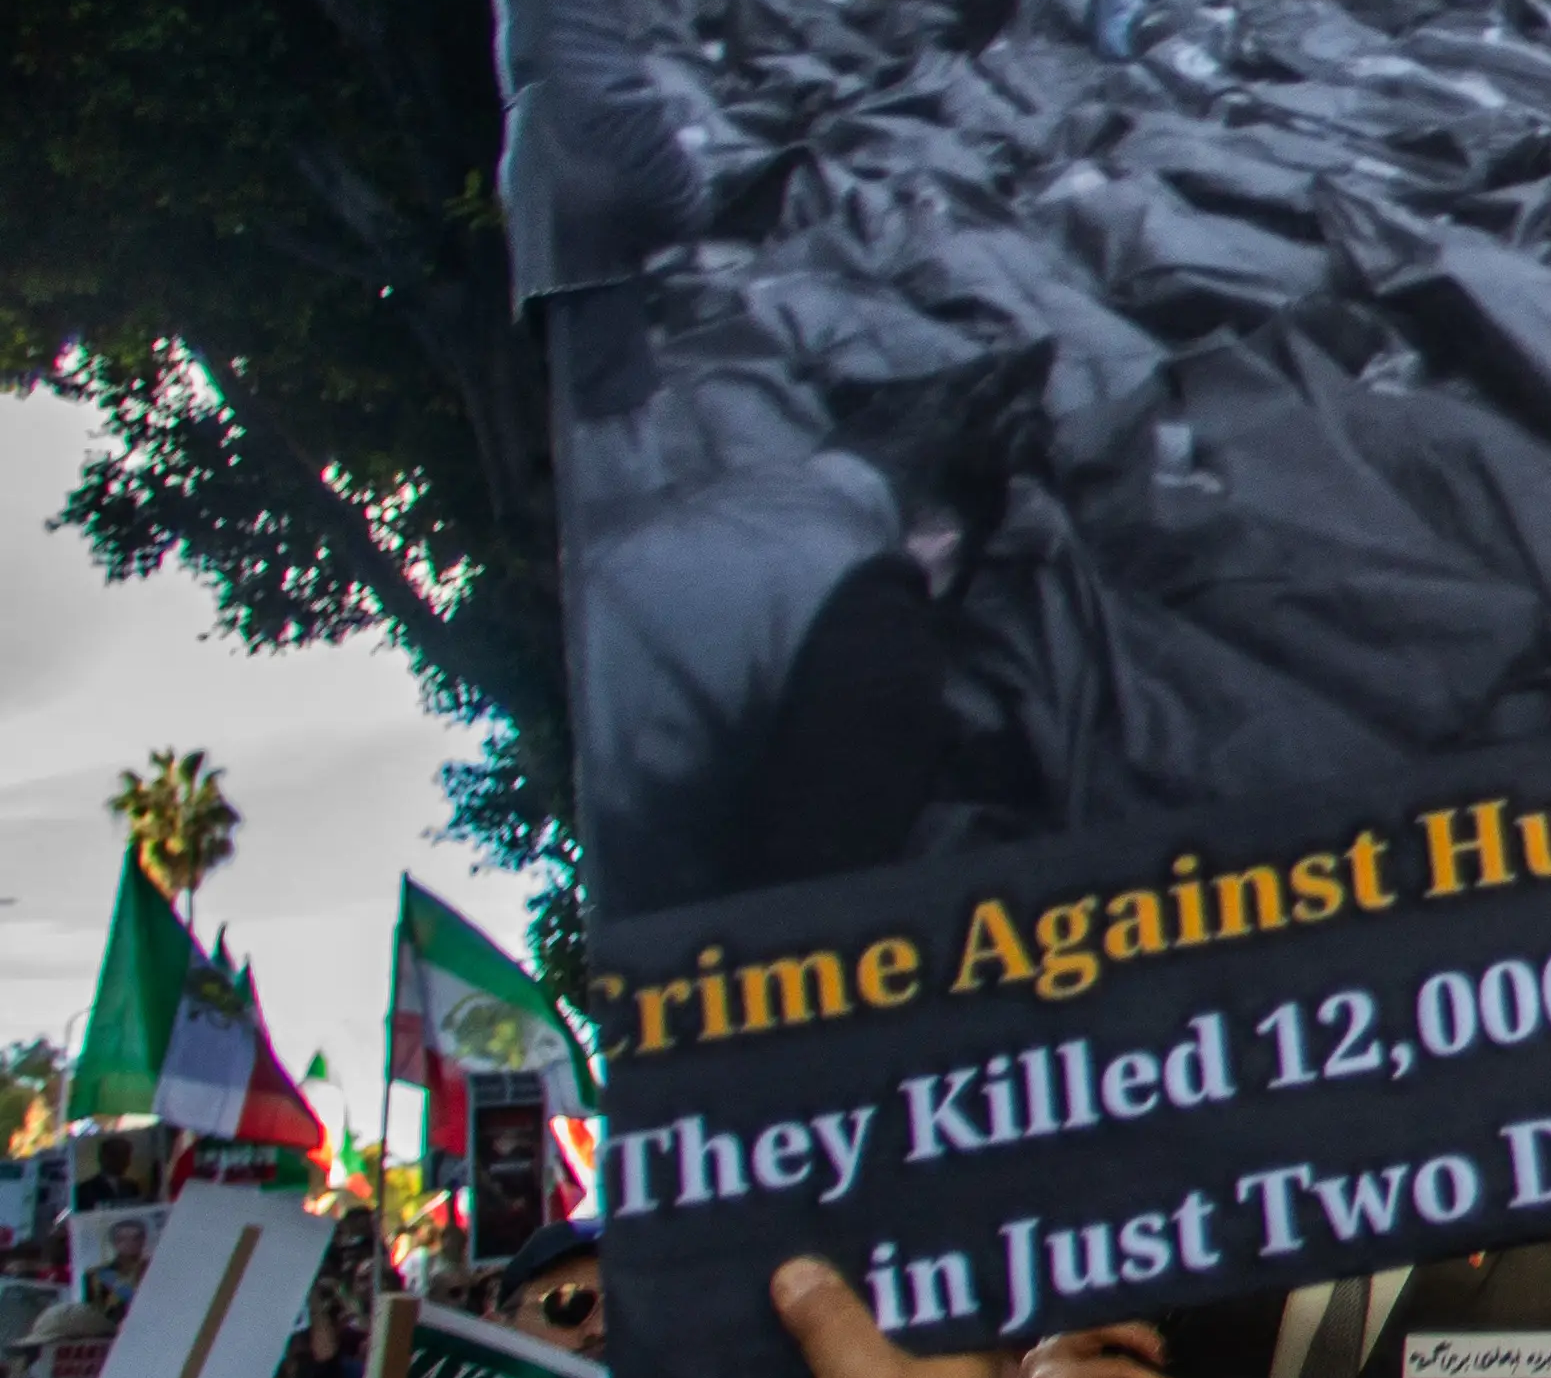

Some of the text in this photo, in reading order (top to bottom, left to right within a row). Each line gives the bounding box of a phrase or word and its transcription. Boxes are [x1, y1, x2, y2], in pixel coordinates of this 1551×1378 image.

[950, 828, 1397, 1000] Against
[603, 1105, 875, 1218] They
[900, 1013, 1235, 1164] Killed
[866, 1241, 979, 1332] in
[998, 1191, 1222, 1334] Just
[1236, 1154, 1479, 1258] Two
